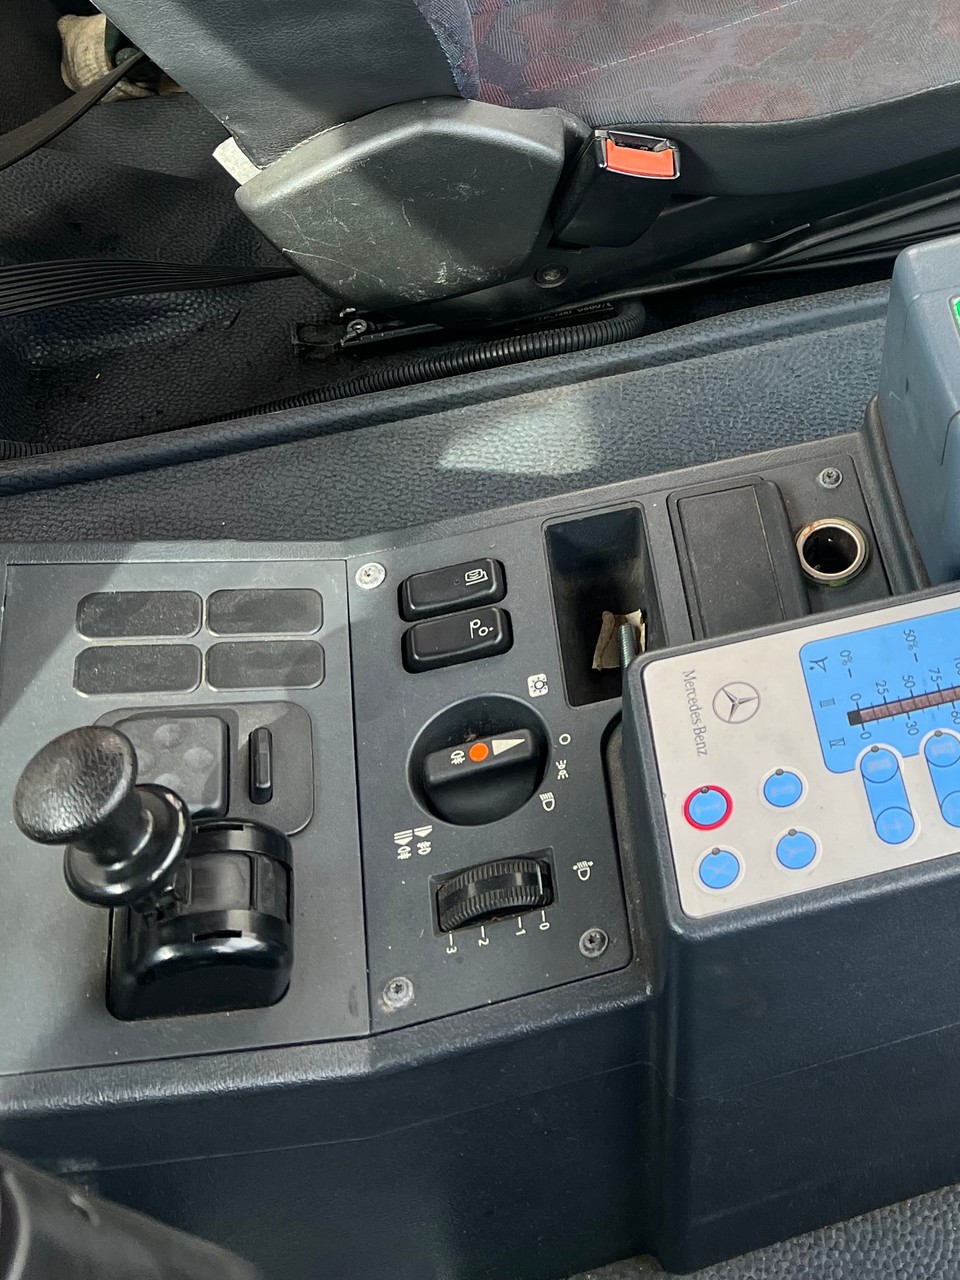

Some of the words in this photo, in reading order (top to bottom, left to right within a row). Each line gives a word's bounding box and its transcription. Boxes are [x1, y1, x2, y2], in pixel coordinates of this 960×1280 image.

[902, 628, 920, 652] 50%
[839, 649, 853, 667] 0%
[901, 674, 916, 689] 50
[928, 667, 943, 683] 75
[875, 680, 890, 696] 25
[850, 692, 862, 701] 0
[860, 731, 872, 741] 0
[905, 721, 920, 737] 30
[445, 944, 458, 954] 3
[478, 936, 490, 948] 2
